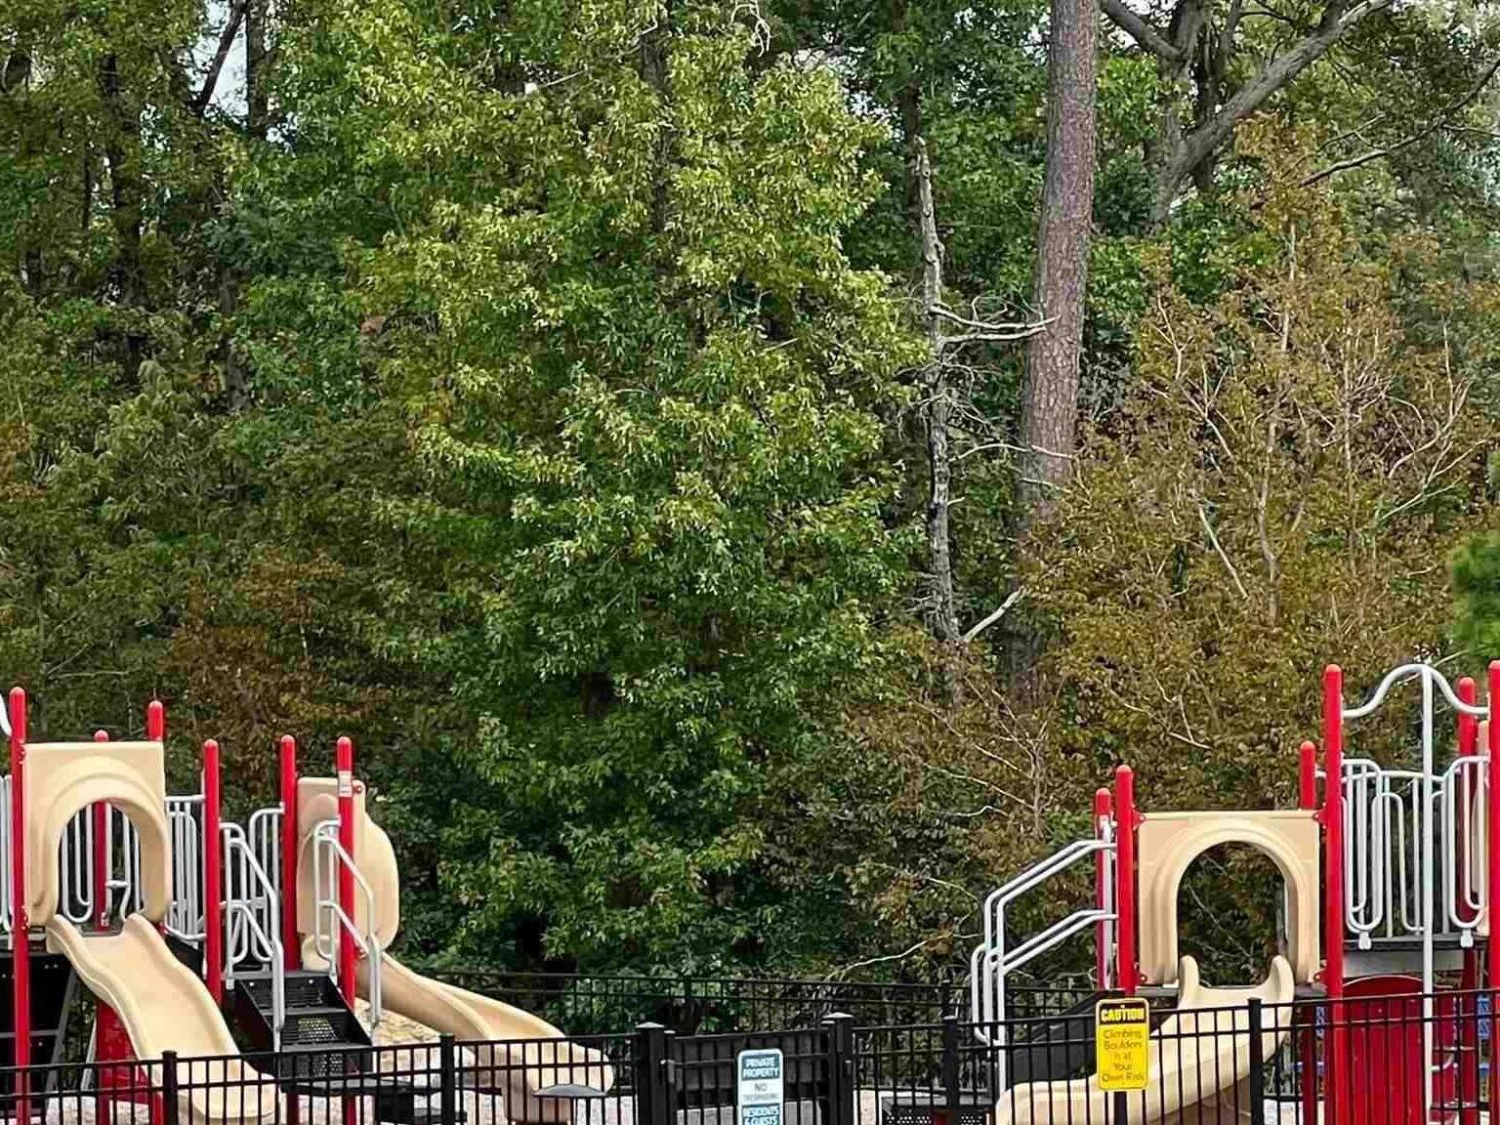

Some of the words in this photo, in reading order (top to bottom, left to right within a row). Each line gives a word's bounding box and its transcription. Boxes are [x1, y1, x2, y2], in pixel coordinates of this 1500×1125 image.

[1101, 1008, 1145, 1021] CAUTION
[746, 1057, 775, 1067] PRIVATE
[743, 1067, 779, 1078] PROPERTY
[754, 1083, 767, 1092] NO
[743, 1106, 779, 1117] RESIDENTS
[751, 1116, 778, 1125] GUESTS
